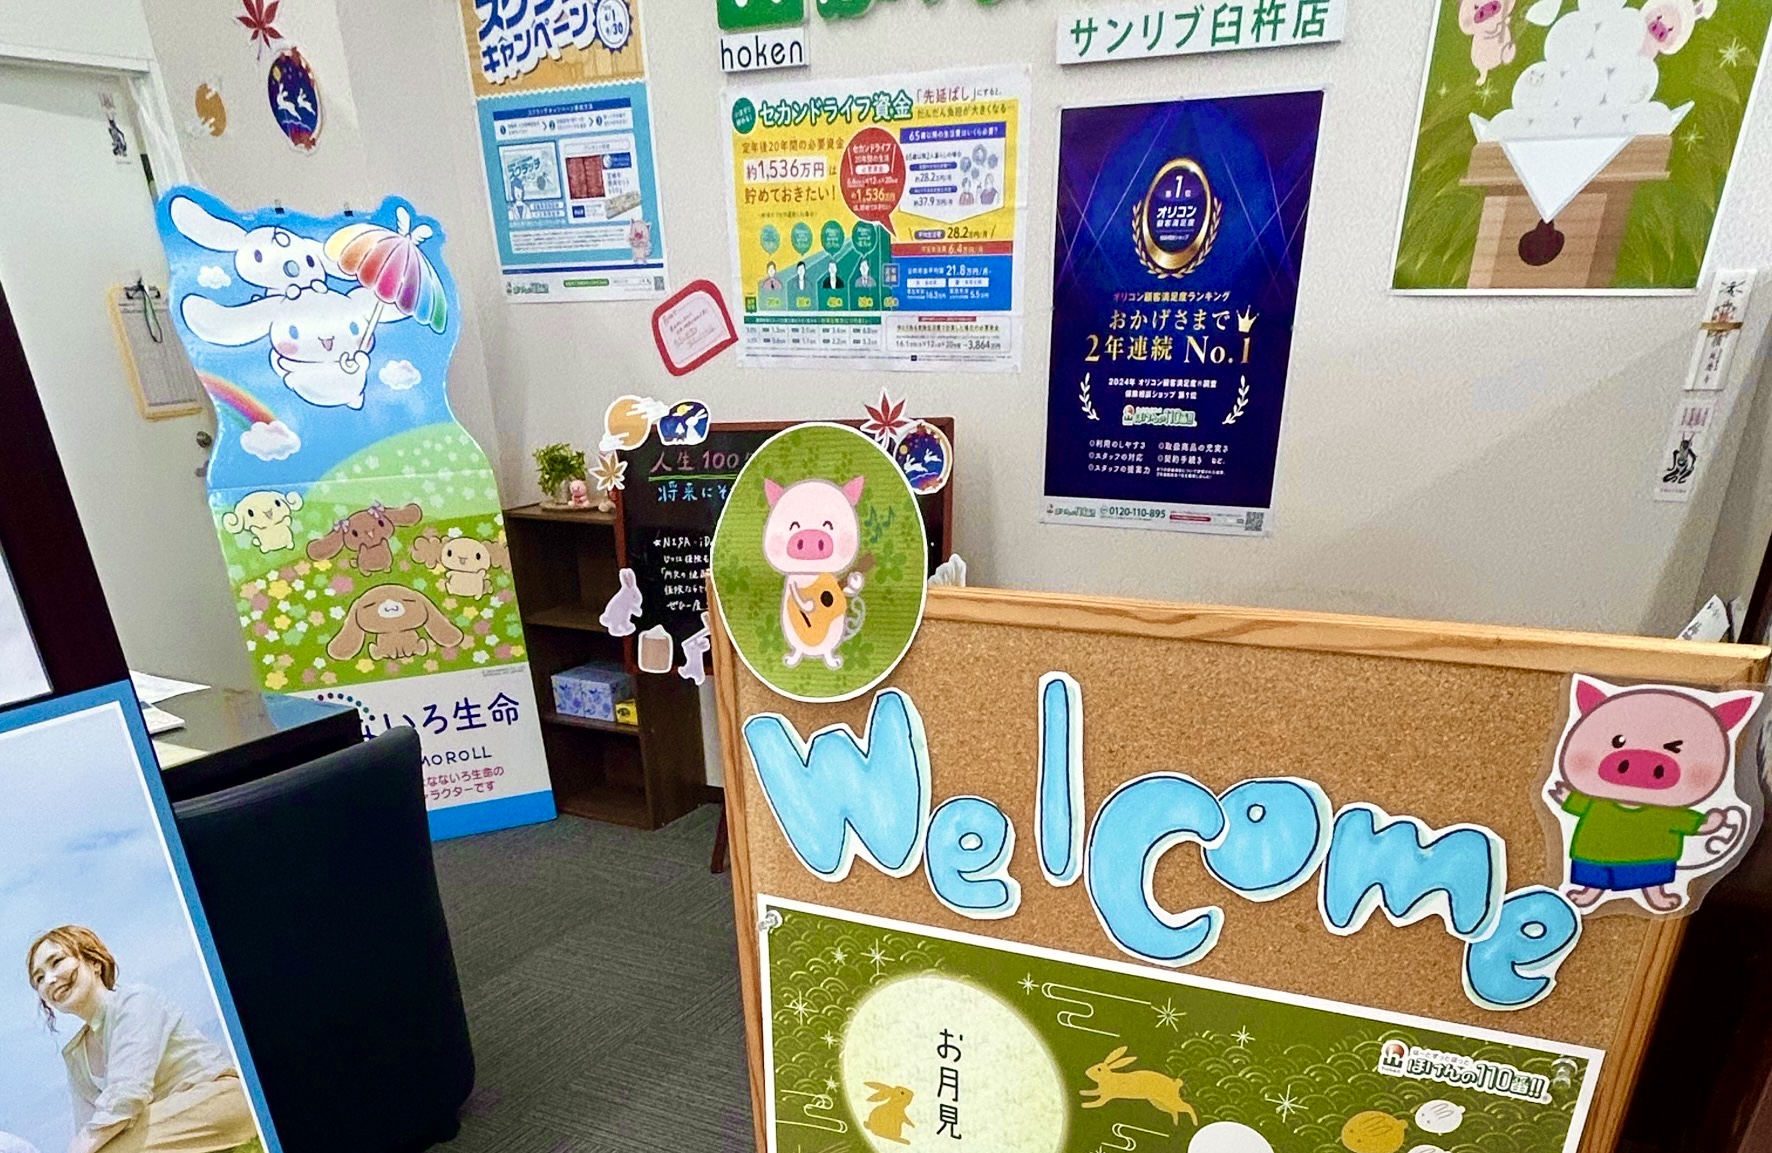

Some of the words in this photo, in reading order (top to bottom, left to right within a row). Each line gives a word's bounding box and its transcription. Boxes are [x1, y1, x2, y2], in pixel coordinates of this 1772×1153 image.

[482, 3, 590, 75] キャンペーン
[1070, 0, 1329, 57] サンリブ臼杵店
[721, 35, 803, 69] hoken
[758, 90, 913, 128] セカンドライフ資金
[742, 137, 844, 154] 定年後20年間の必要資金
[1156, 205, 1197, 219] オリコン
[1113, 290, 1231, 302] オリコン顧客満足度ランキング
[1109, 308, 1230, 331] おかげさまで
[1084, 334, 1173, 363] 2年連続
[650, 450, 752, 473] 人生100
[1109, 506, 1166, 519] 0120-110-895
[936, 1028, 963, 1140] お月見
